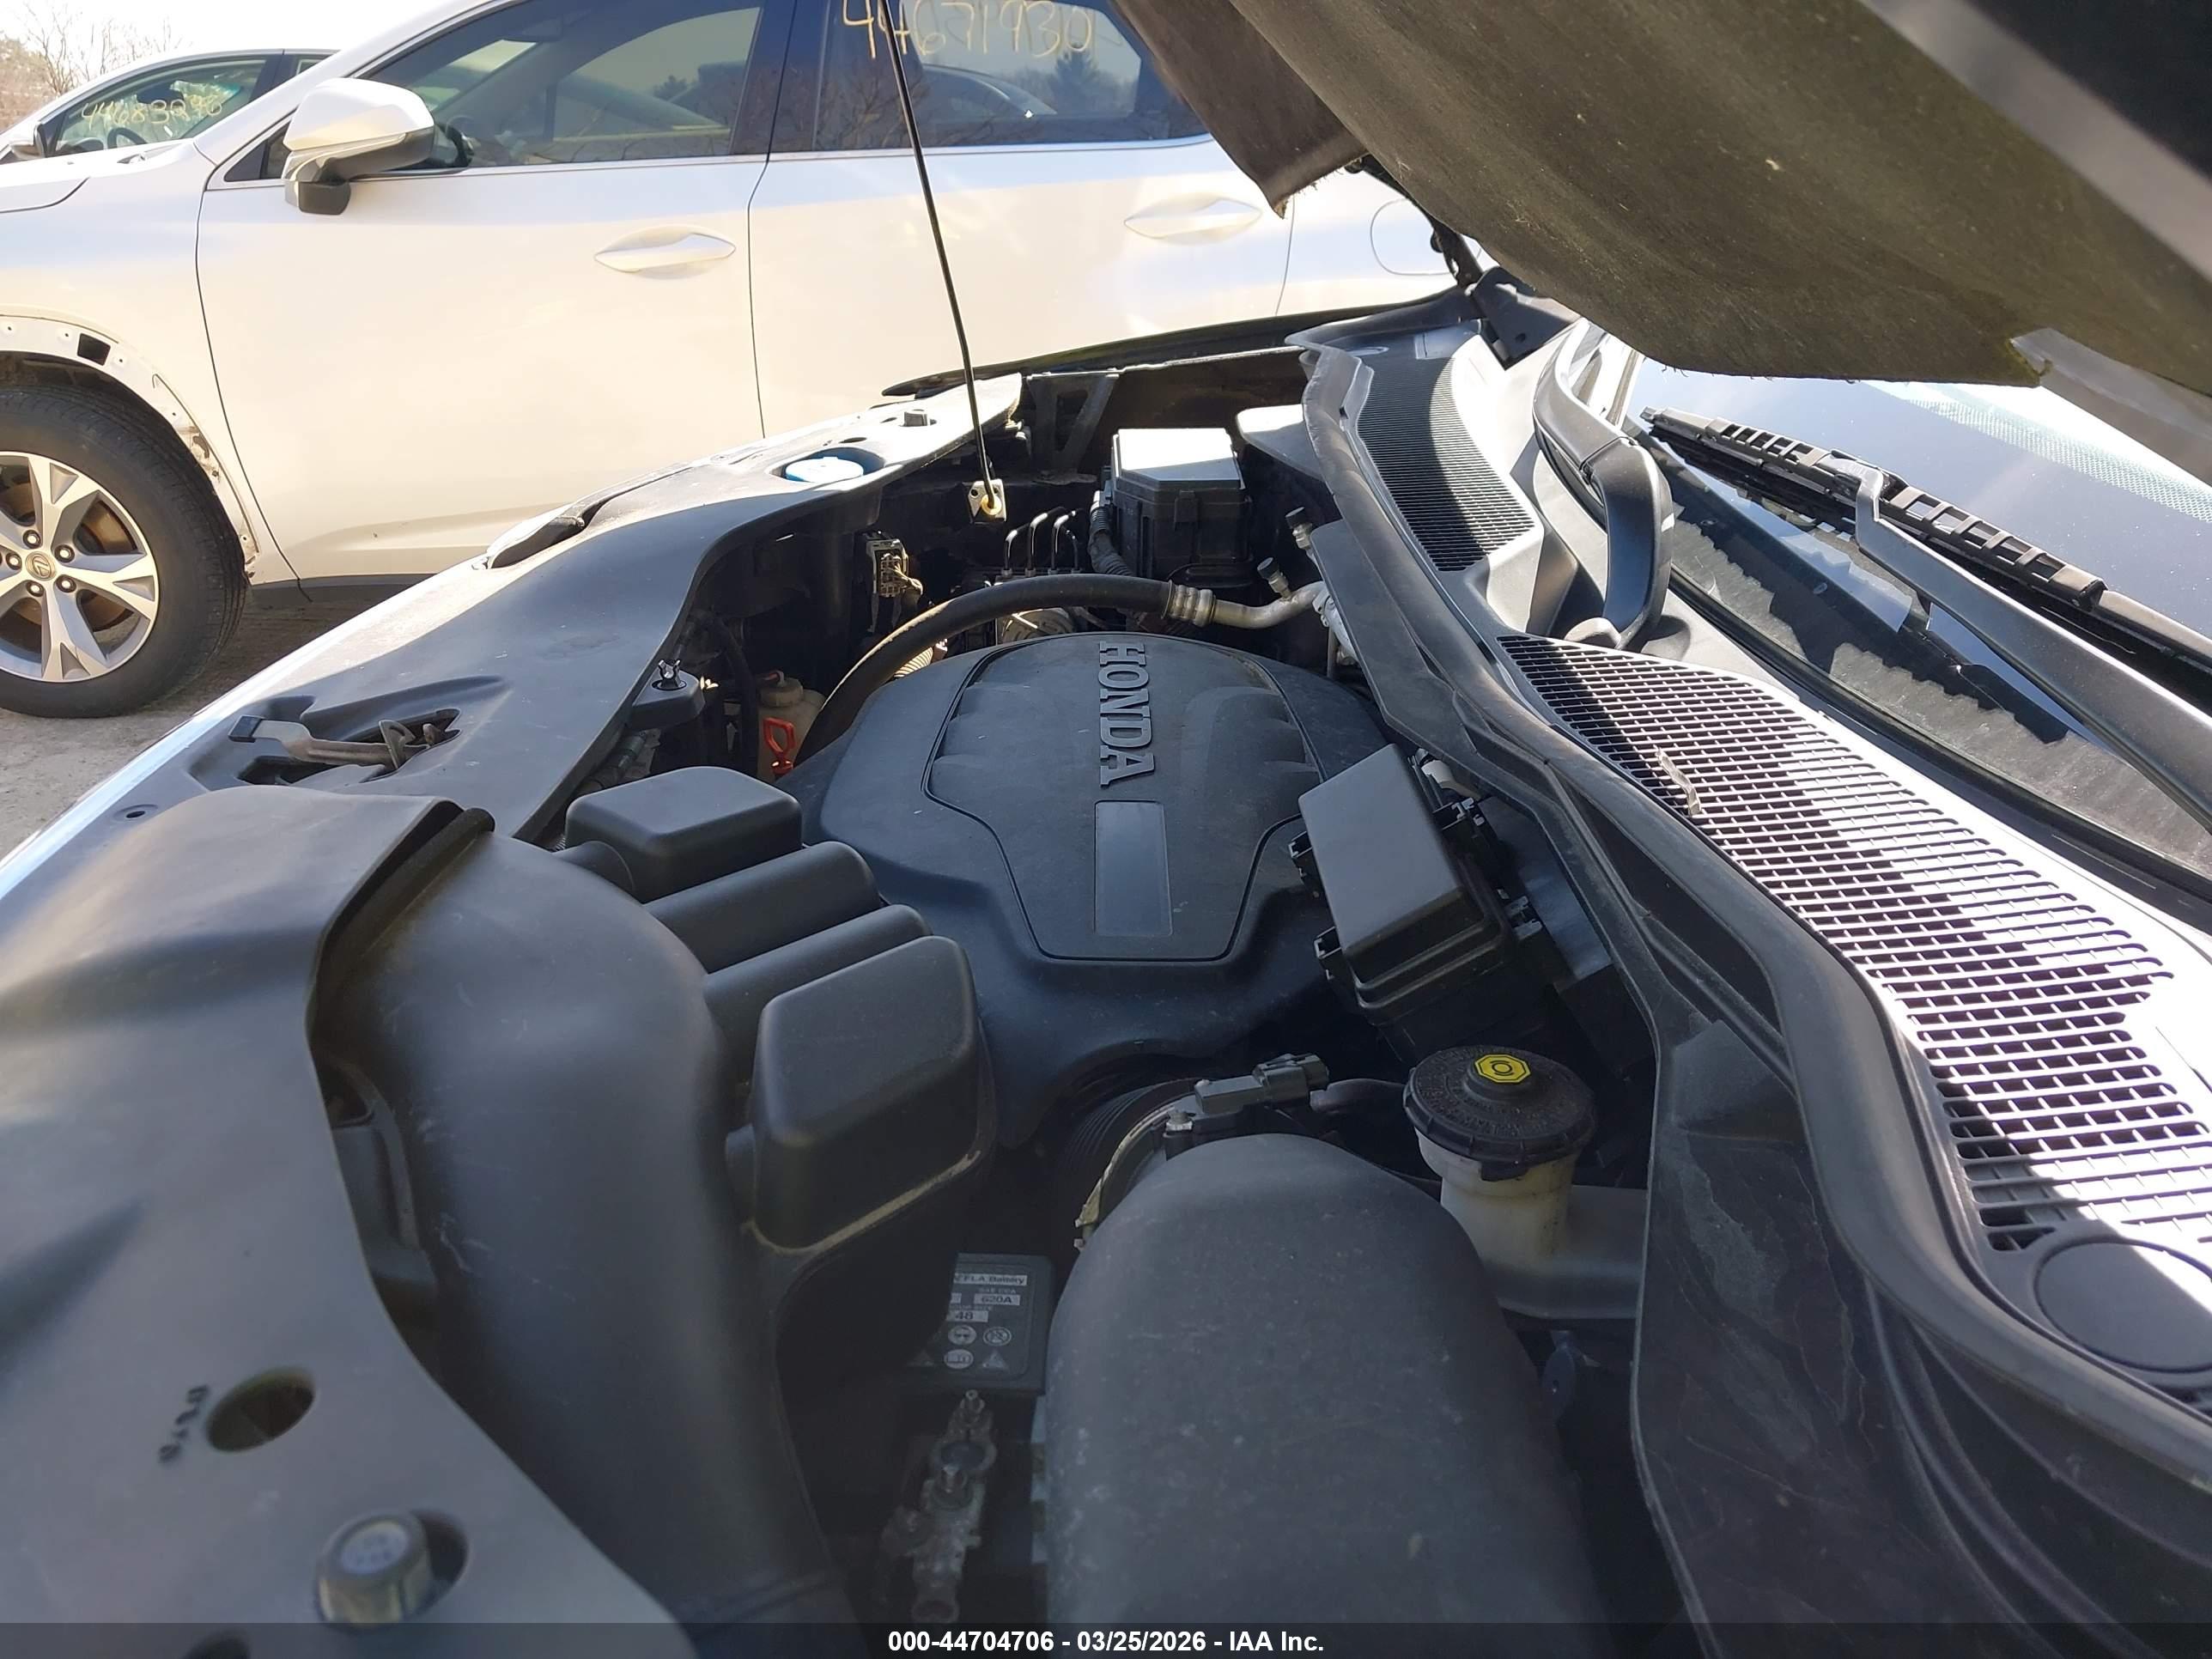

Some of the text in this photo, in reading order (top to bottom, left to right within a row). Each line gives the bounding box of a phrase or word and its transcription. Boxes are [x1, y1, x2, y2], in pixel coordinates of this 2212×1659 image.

[1098, 641, 1156, 787] HONDA
[988, 1275, 1025, 1285] Battery
[981, 1295, 1012, 1304] 620A
[955, 1311, 974, 1320] 48
